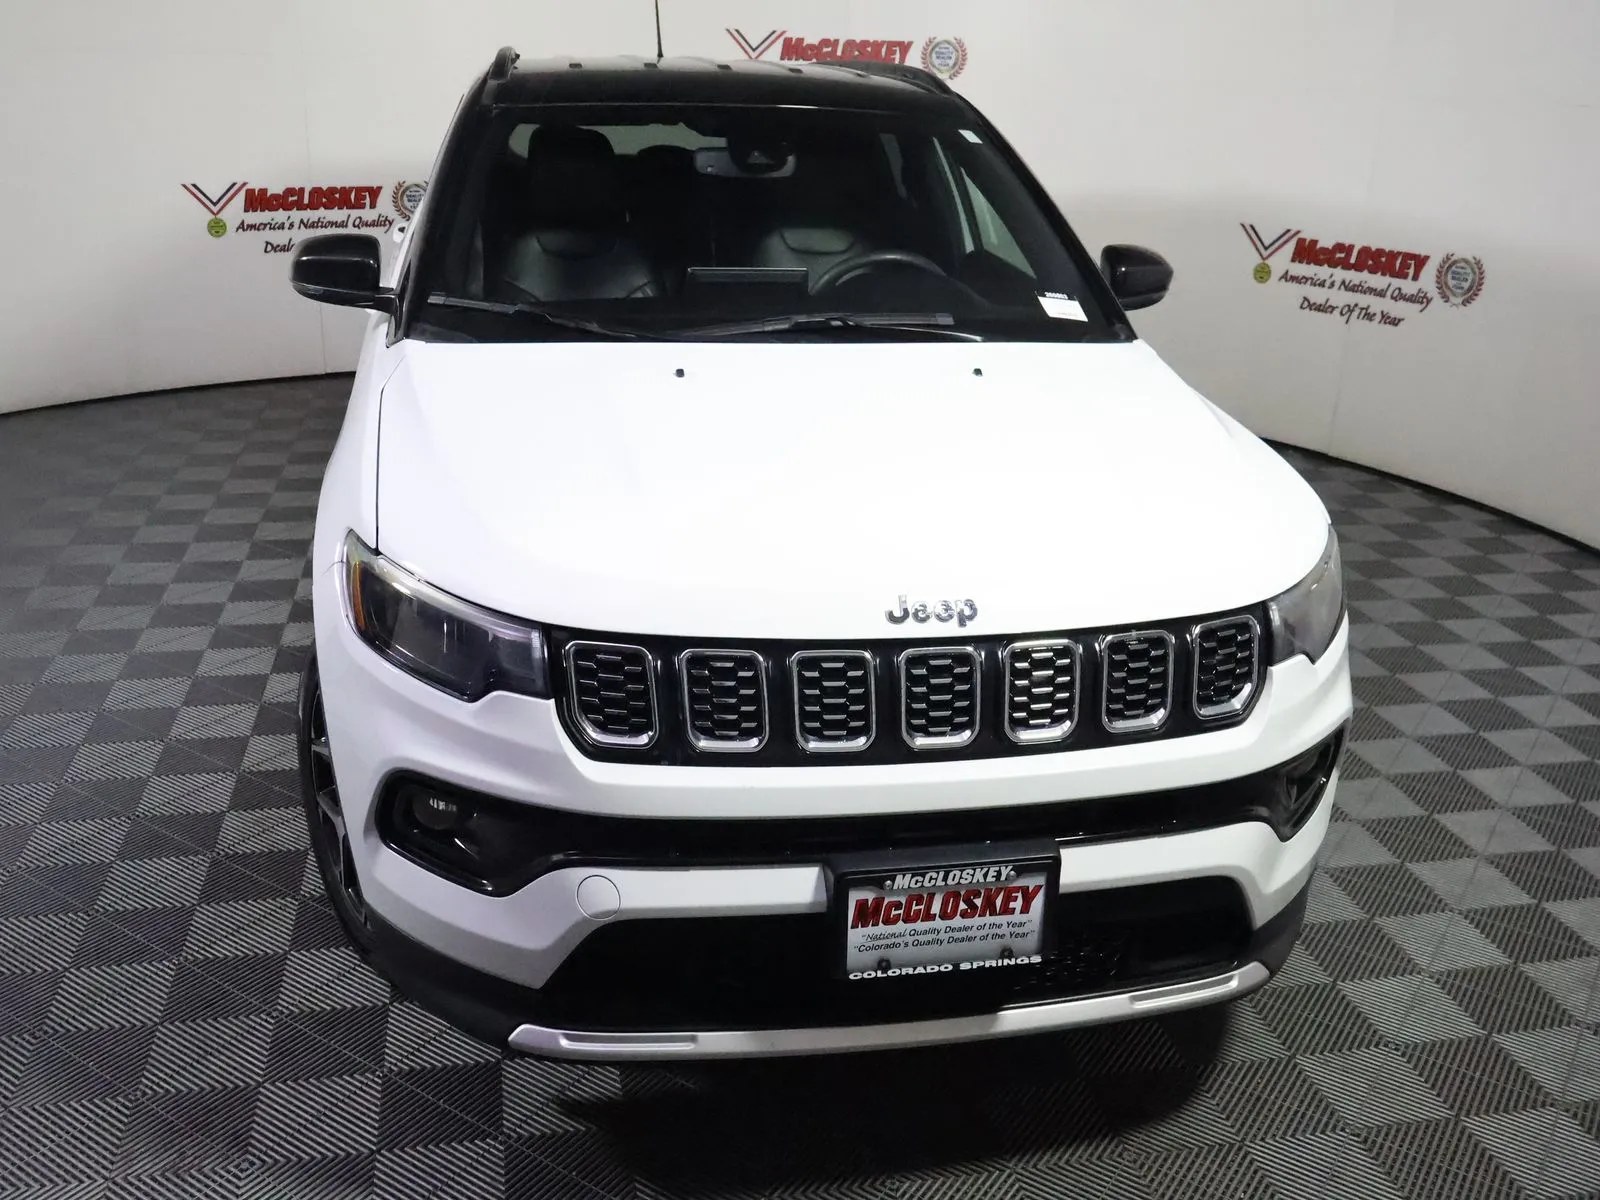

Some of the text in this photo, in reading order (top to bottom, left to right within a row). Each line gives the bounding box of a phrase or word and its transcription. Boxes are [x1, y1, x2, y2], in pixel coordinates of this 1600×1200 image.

[780, 37, 914, 64] McCLOSKEY
[244, 186, 382, 213] McCLOSKEY
[235, 216, 295, 232] America's
[298, 214, 351, 230] National
[352, 214, 395, 233] Quality
[1290, 237, 1430, 282] McCLOSKEY
[1278, 269, 1336, 290] America's
[1338, 280, 1392, 299] National
[1390, 286, 1434, 313] Quality
[1299, 296, 1405, 327] Dealer Of The Year
[885, 594, 978, 628] Jeep
[893, 865, 1013, 890] McCLOSKEY
[850, 884, 1044, 930] McCLOSKEY
[908, 926, 942, 937] Quality
[944, 924, 974, 934] Dealer
[976, 922, 987, 931] of
[988, 921, 1004, 930] the
[911, 937, 945, 947] Quality
[947, 934, 977, 944] Dealer
[979, 932, 990, 941] of
[991, 931, 1006, 940] the
[848, 955, 1043, 980] COLORADO SPRINGS
